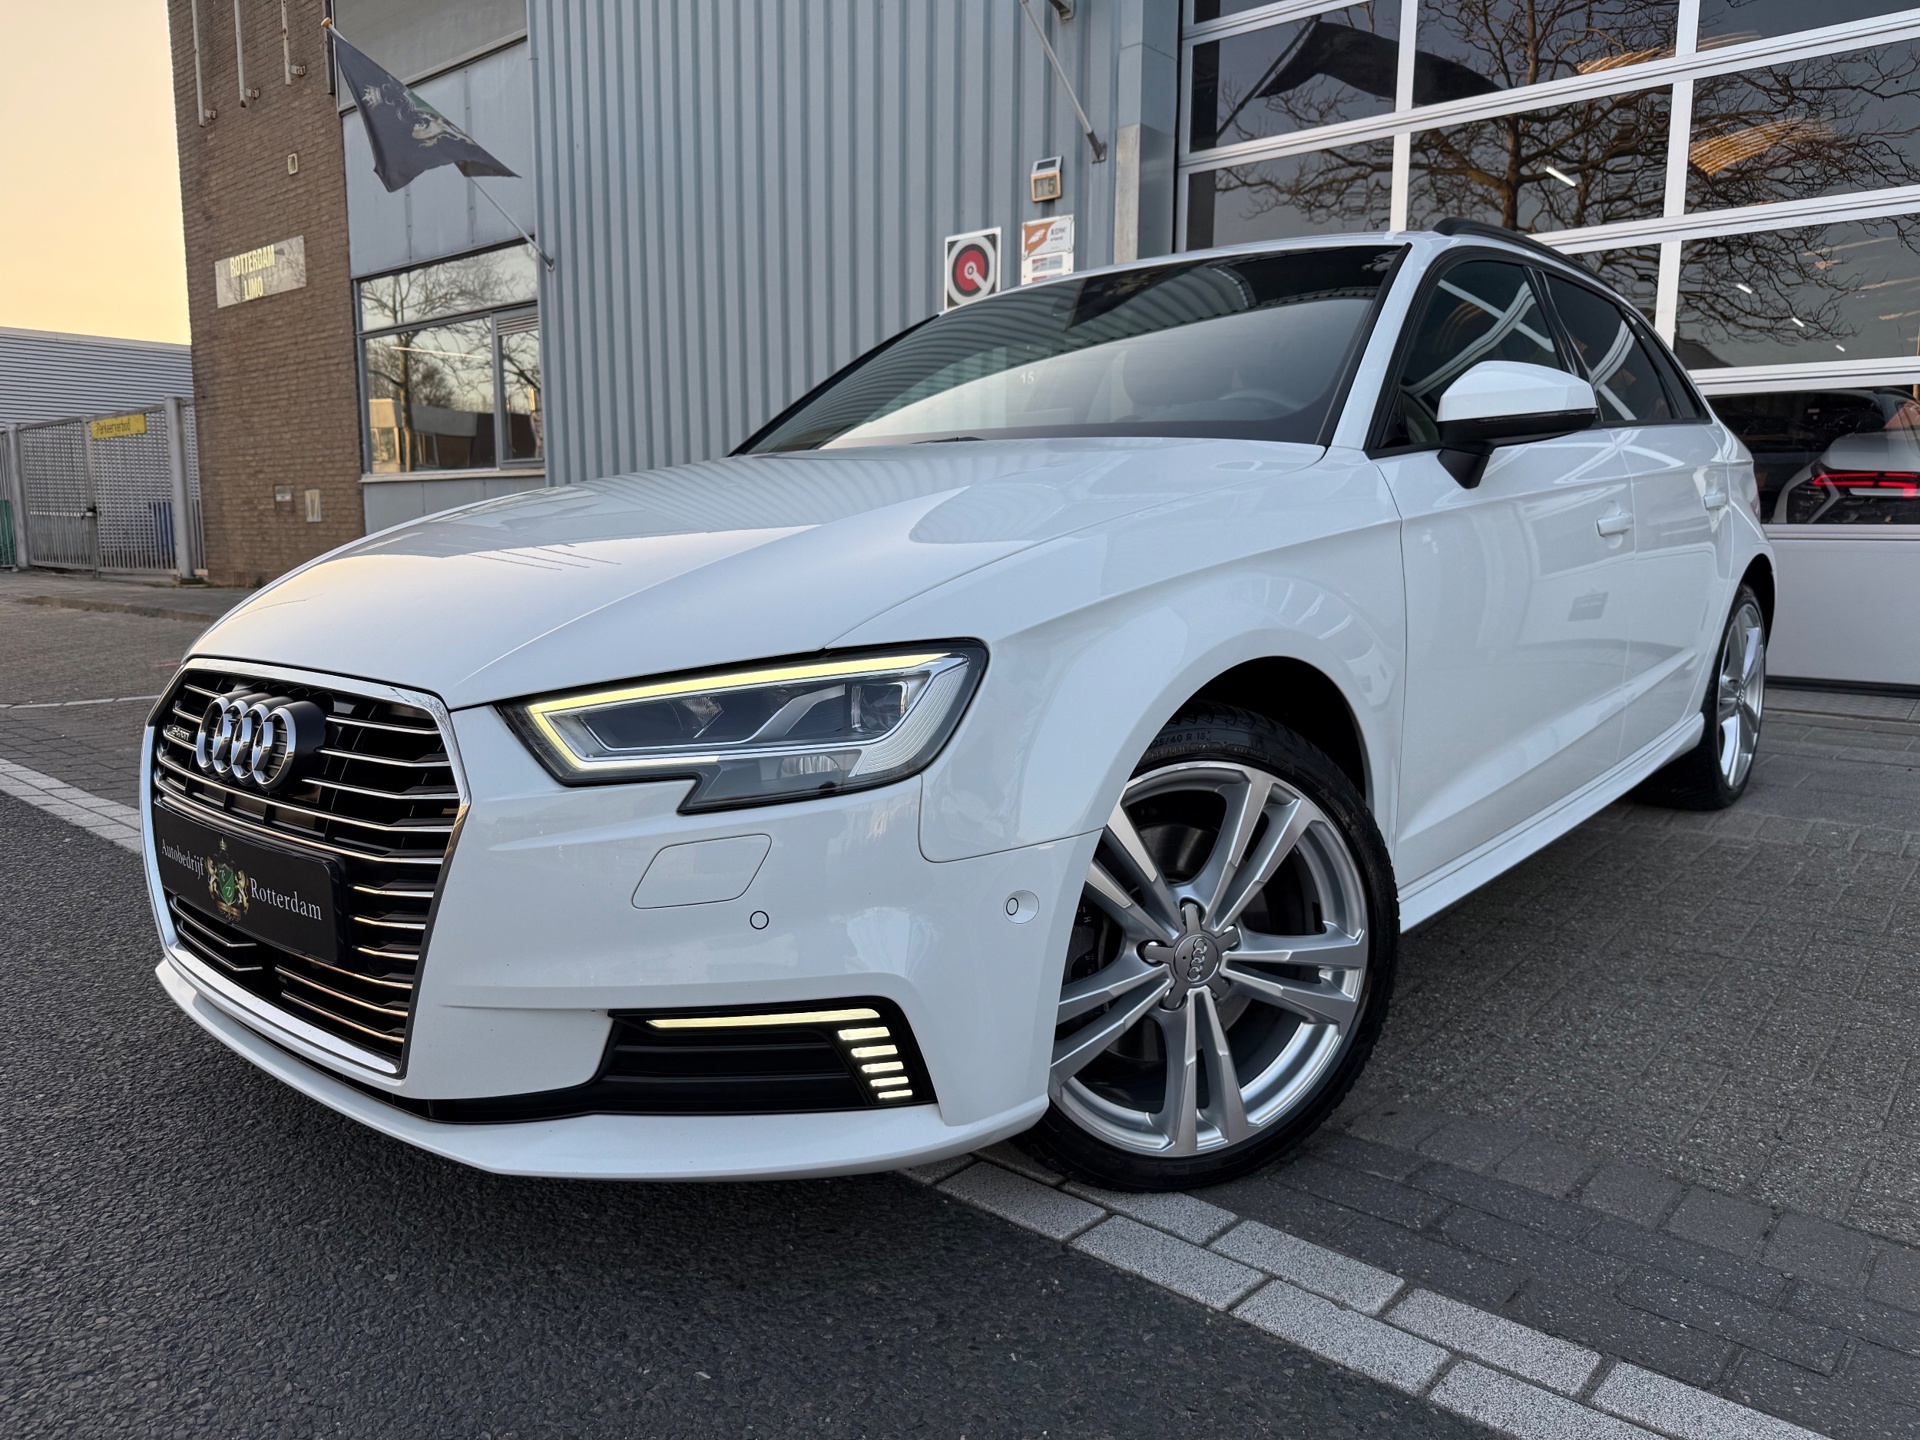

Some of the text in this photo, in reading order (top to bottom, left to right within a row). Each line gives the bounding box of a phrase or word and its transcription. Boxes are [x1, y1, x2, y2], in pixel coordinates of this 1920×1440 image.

[229, 244, 276, 278] ROTTERDAM
[243, 275, 264, 301] LIMO
[1149, 735, 1183, 748] 25/40
[161, 838, 205, 880] Autobedrijf
[249, 877, 323, 921] Rotterdam
